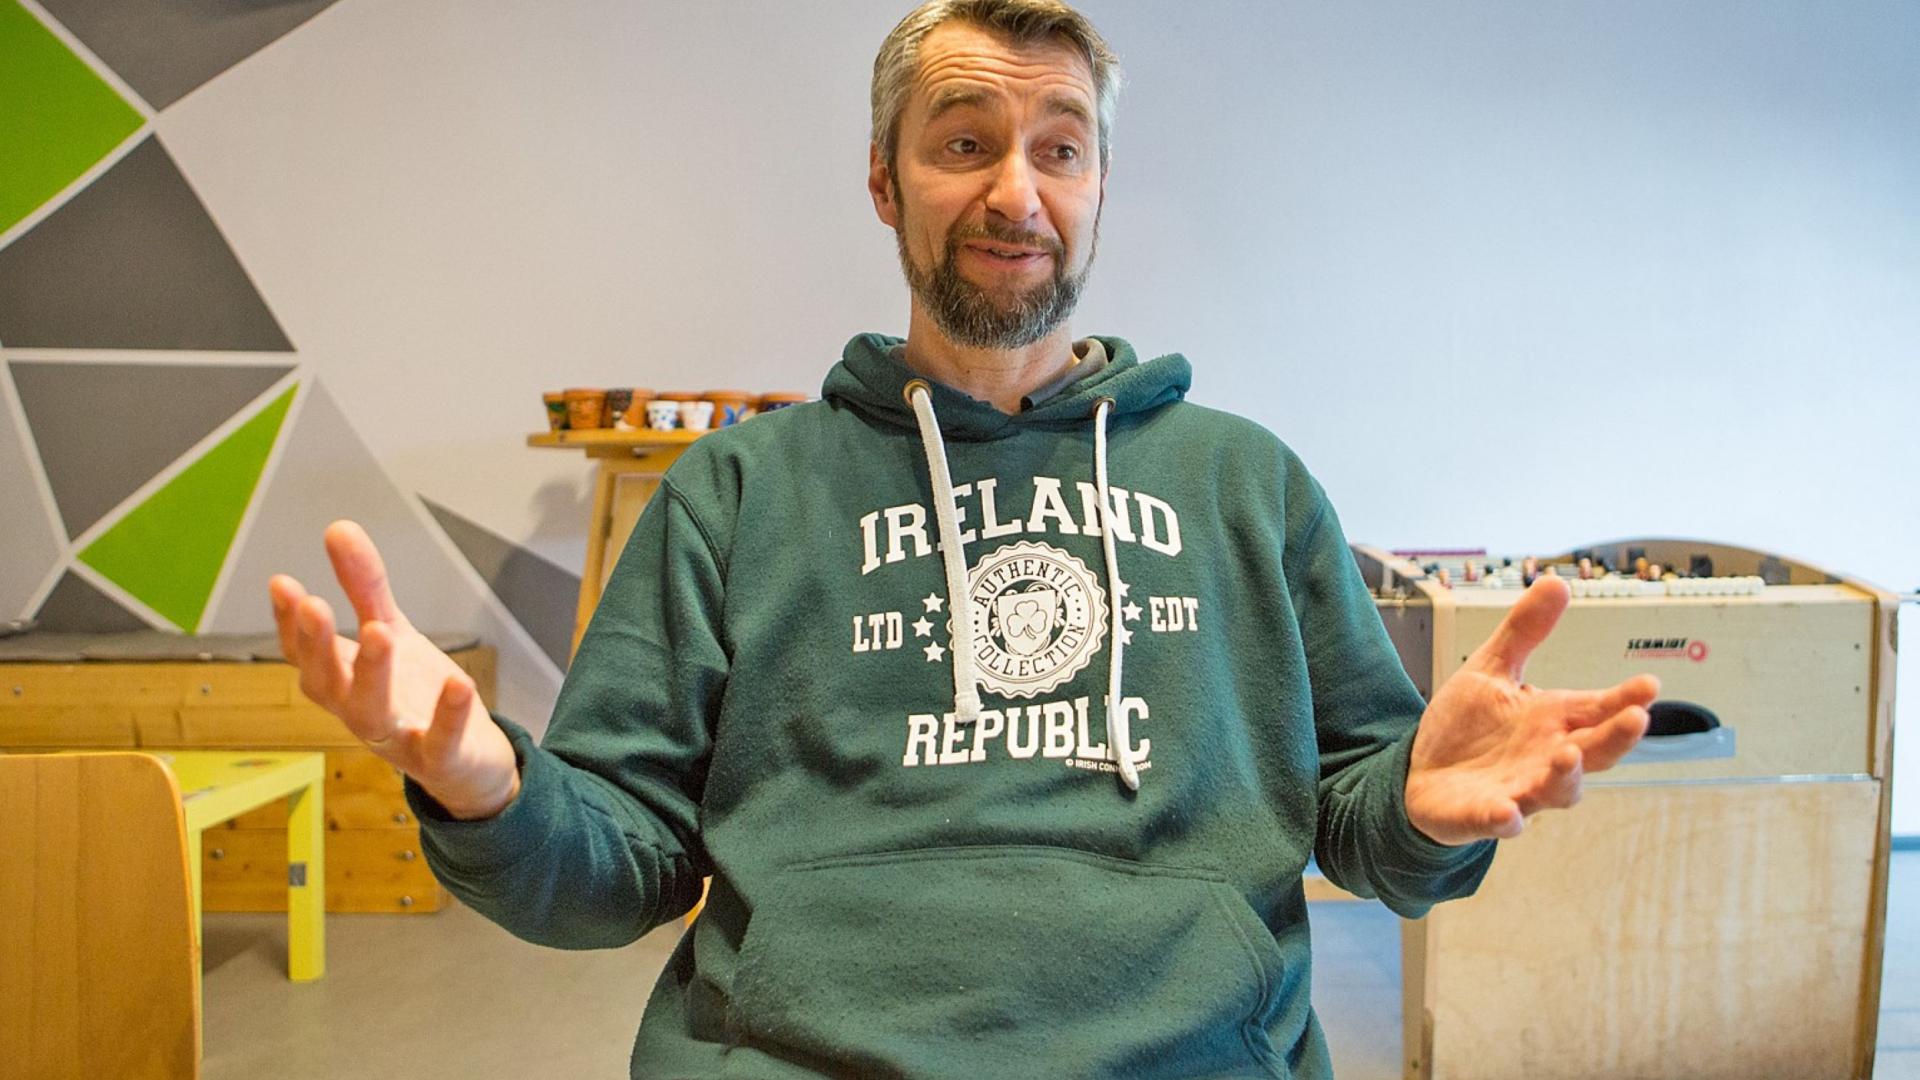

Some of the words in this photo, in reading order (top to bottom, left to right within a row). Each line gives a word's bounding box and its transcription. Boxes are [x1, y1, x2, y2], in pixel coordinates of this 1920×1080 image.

[973, 559, 1082, 609] AUTHENTIC
[853, 611, 903, 653] LTD
[1149, 596, 1199, 632] EDT
[973, 623, 1086, 677] COLLECTION
[903, 696, 1151, 767] REPUBLC
[1075, 759, 1098, 770] IRISH
[1098, 760, 1152, 773] CONION
